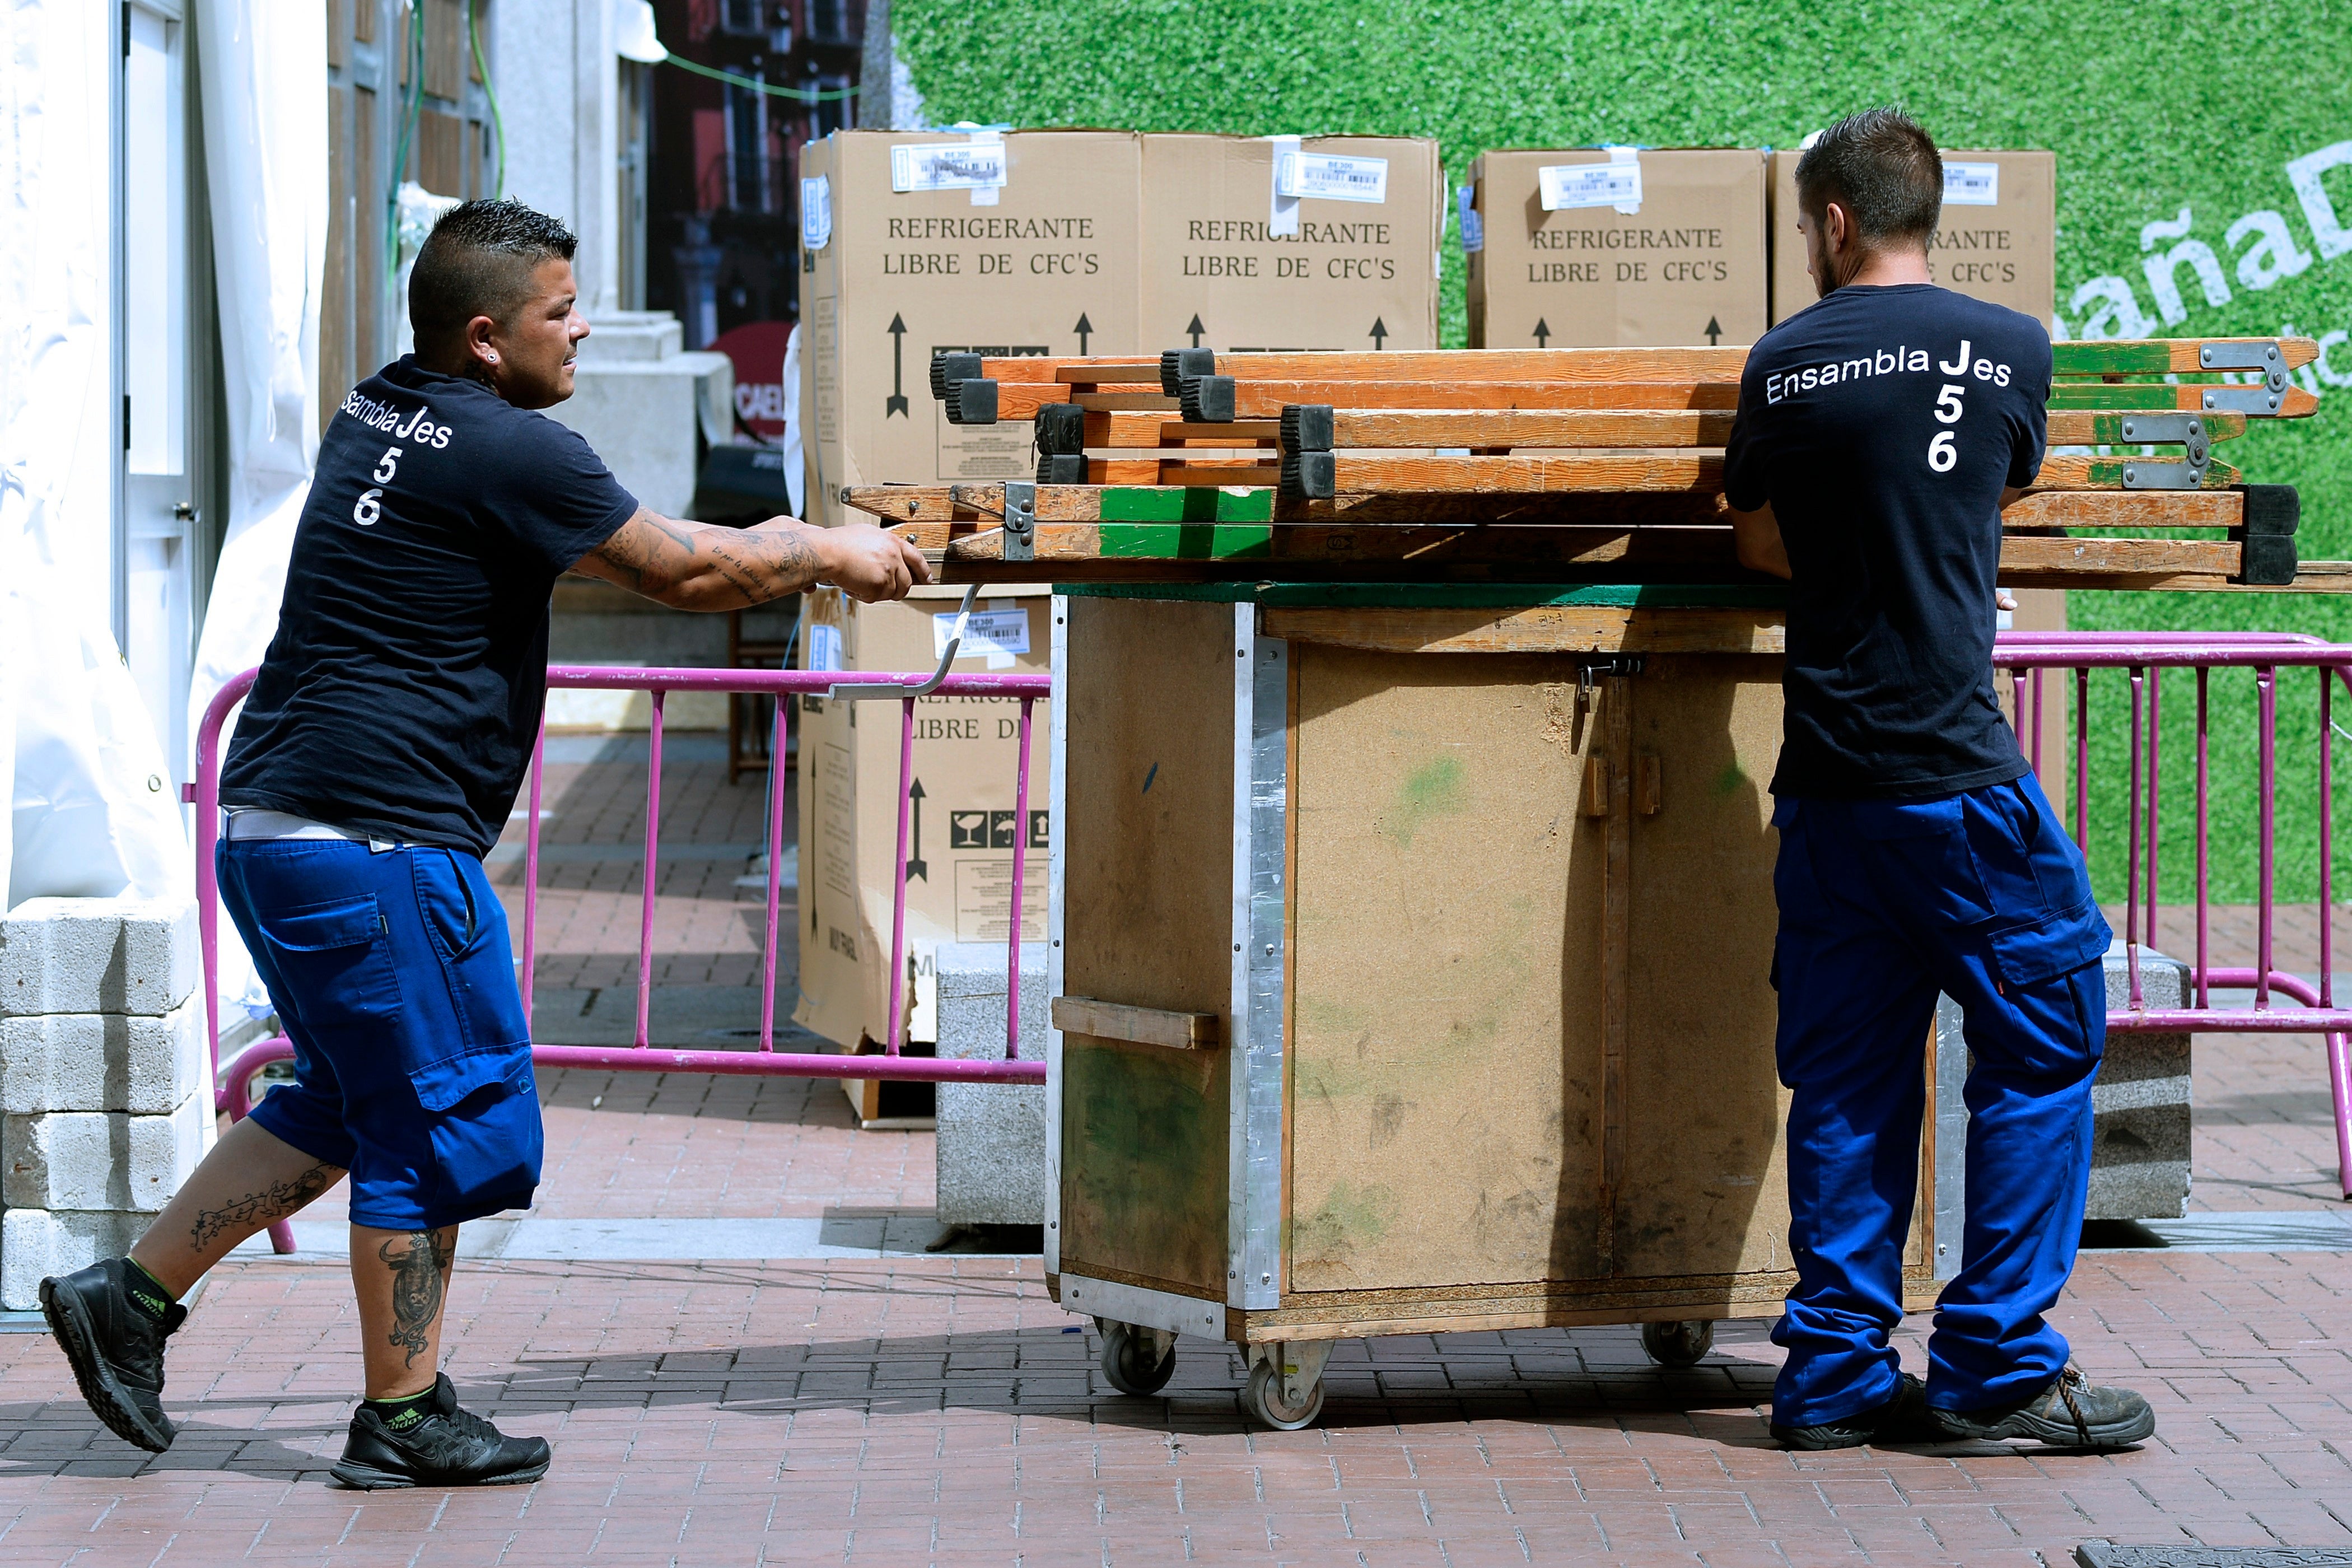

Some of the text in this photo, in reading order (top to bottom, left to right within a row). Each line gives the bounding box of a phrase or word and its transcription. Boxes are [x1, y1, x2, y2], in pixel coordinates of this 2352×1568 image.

[889, 218, 1094, 239] REFRIGERANTE
[1188, 220, 1390, 245] REFRIRANTE
[1532, 228, 1722, 249] REFRIGERANTE
[1932, 229, 2010, 250] RANTE
[2053, 139, 2352, 340] añaD
[884, 253, 1099, 274] LIBRE DE CFC'S
[1183, 255, 1394, 279] LIBRE DE CFC'S
[1528, 260, 1728, 283] LIBRE DE CFC'S
[1952, 262, 2015, 282] CFC'S
[1934, 384, 1965, 424] 5
[340, 389, 452, 449] samblaJes
[1928, 430, 1958, 472] 6
[374, 446, 403, 484] 5
[353, 488, 383, 525] 6
[997, 718, 1020, 739] D
[384, 1414, 423, 1430] didas
